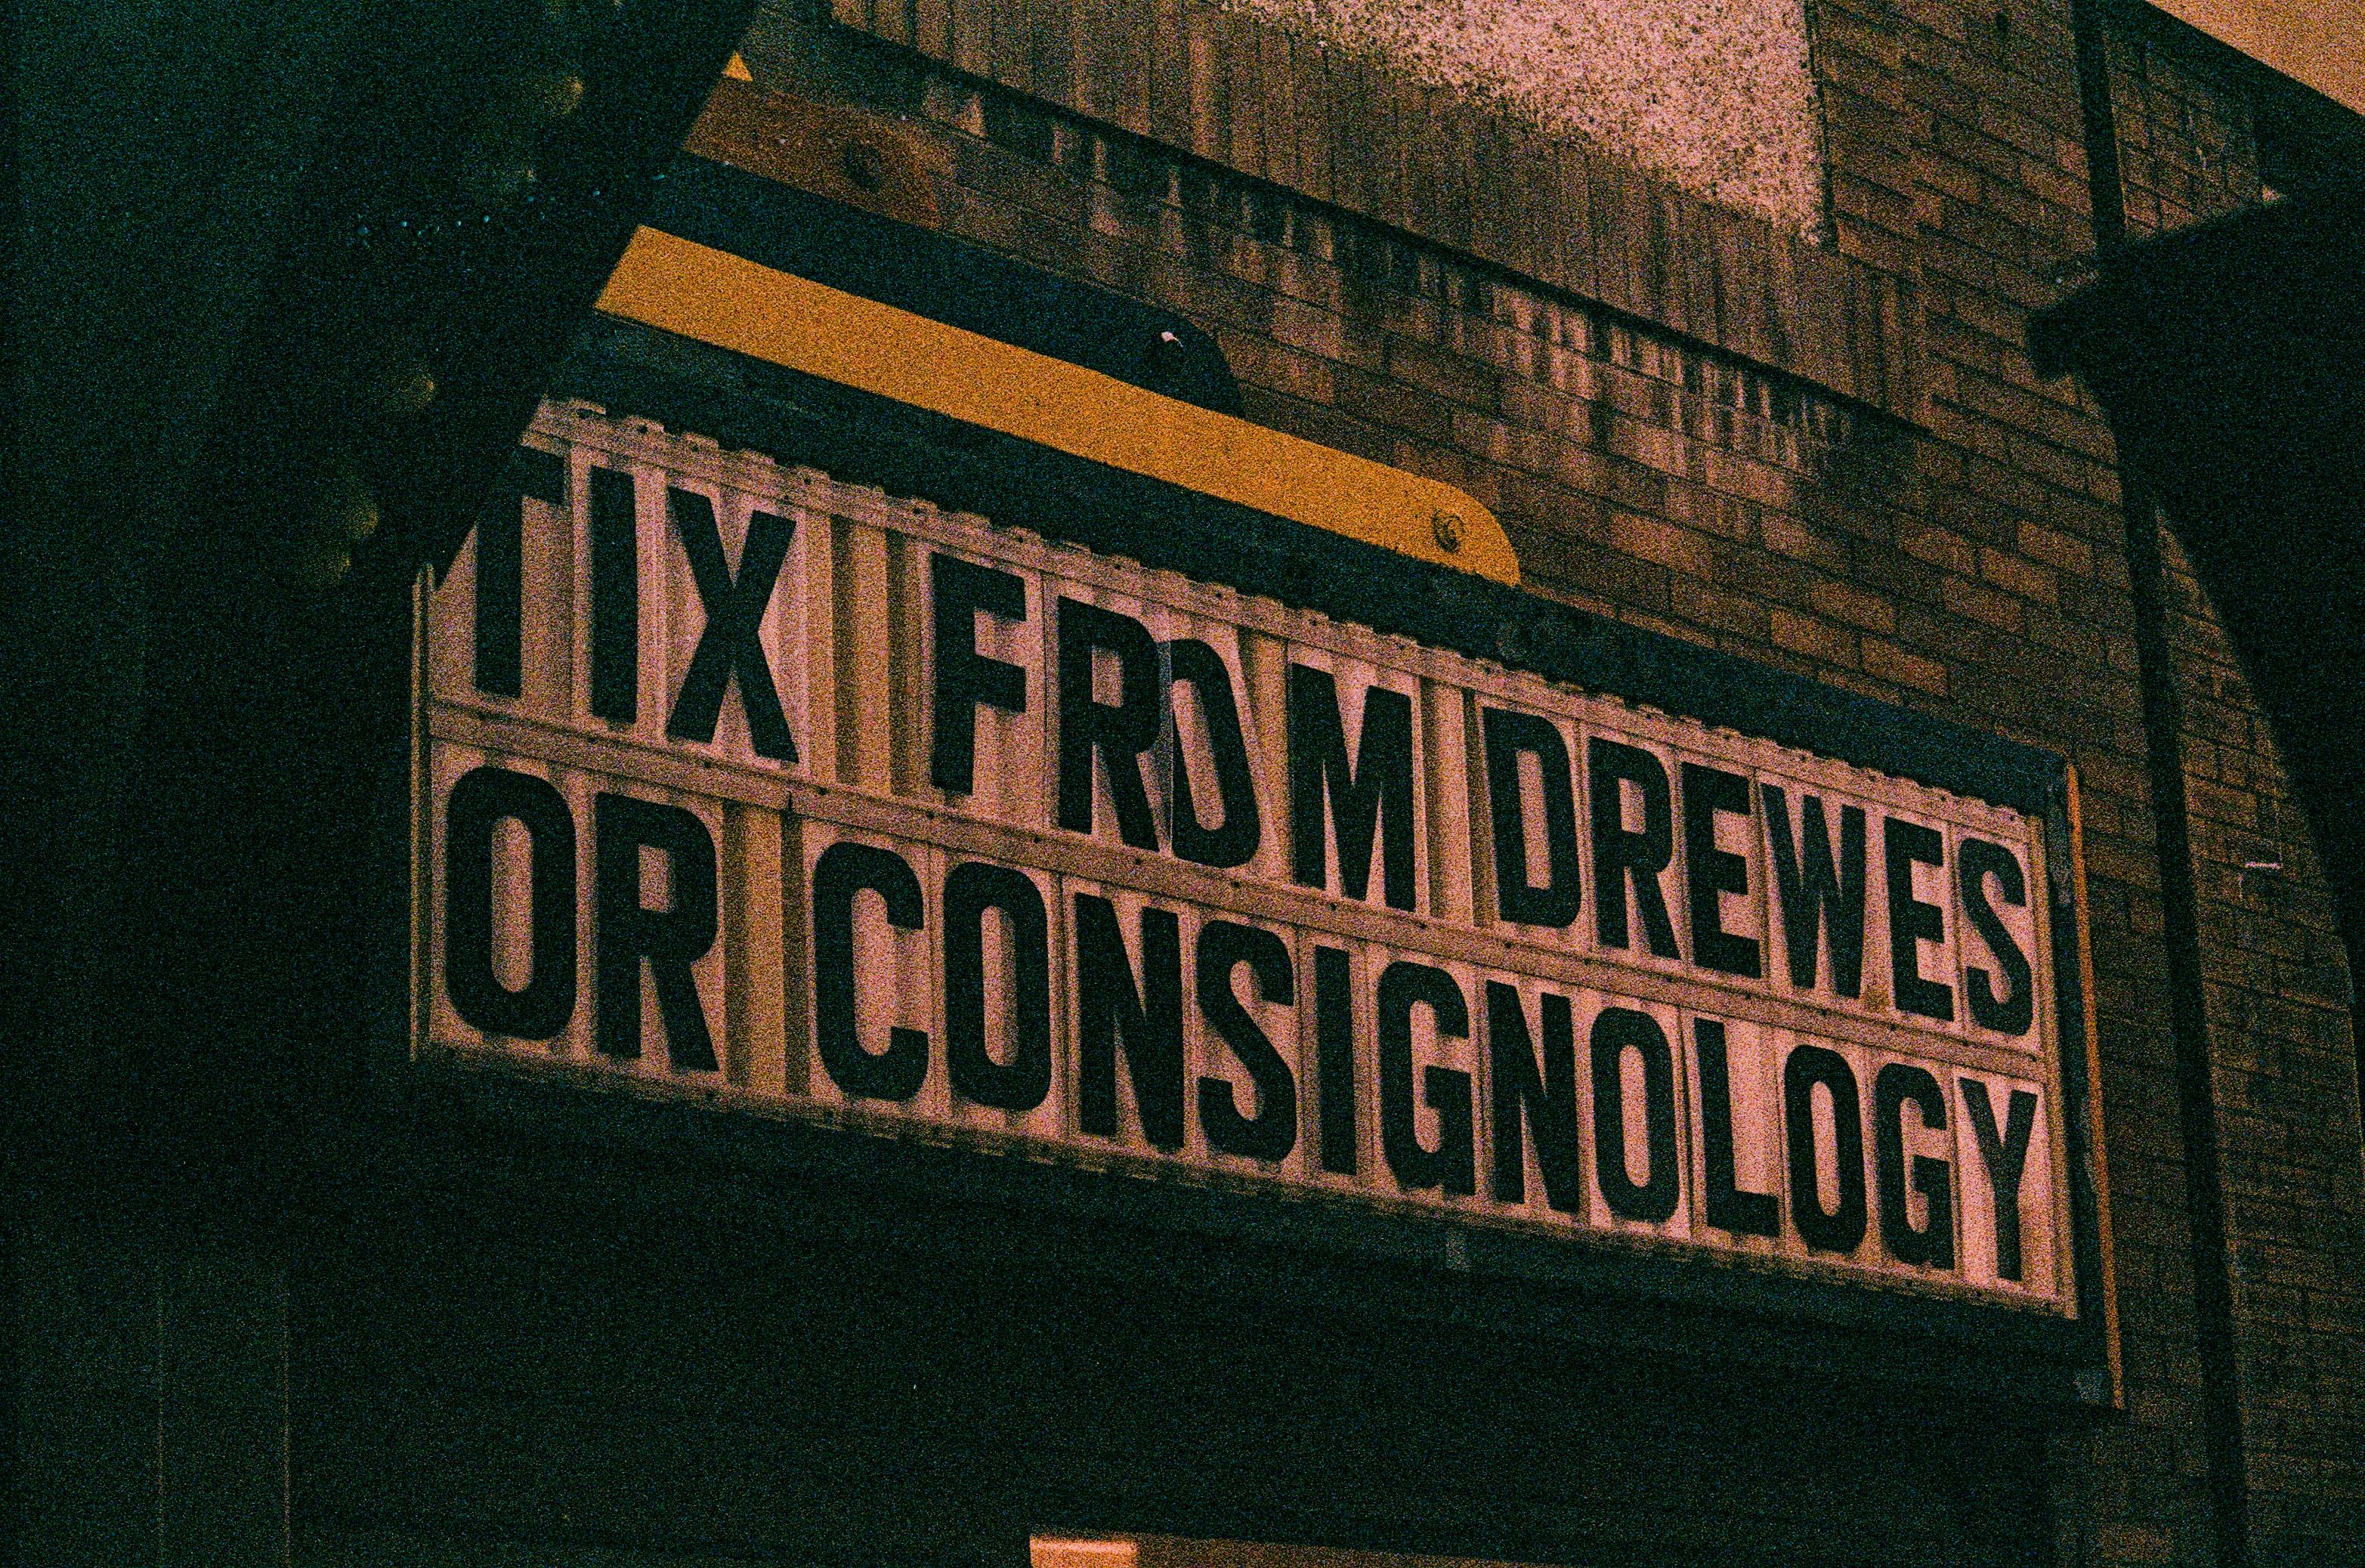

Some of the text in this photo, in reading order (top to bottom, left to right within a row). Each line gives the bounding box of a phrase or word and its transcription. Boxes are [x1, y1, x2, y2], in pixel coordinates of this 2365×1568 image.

[444, 763, 2038, 1282] OR CONSIGNOLOGY
[929, 551, 1417, 913] FROM
[1482, 707, 2033, 1036] DREWES
